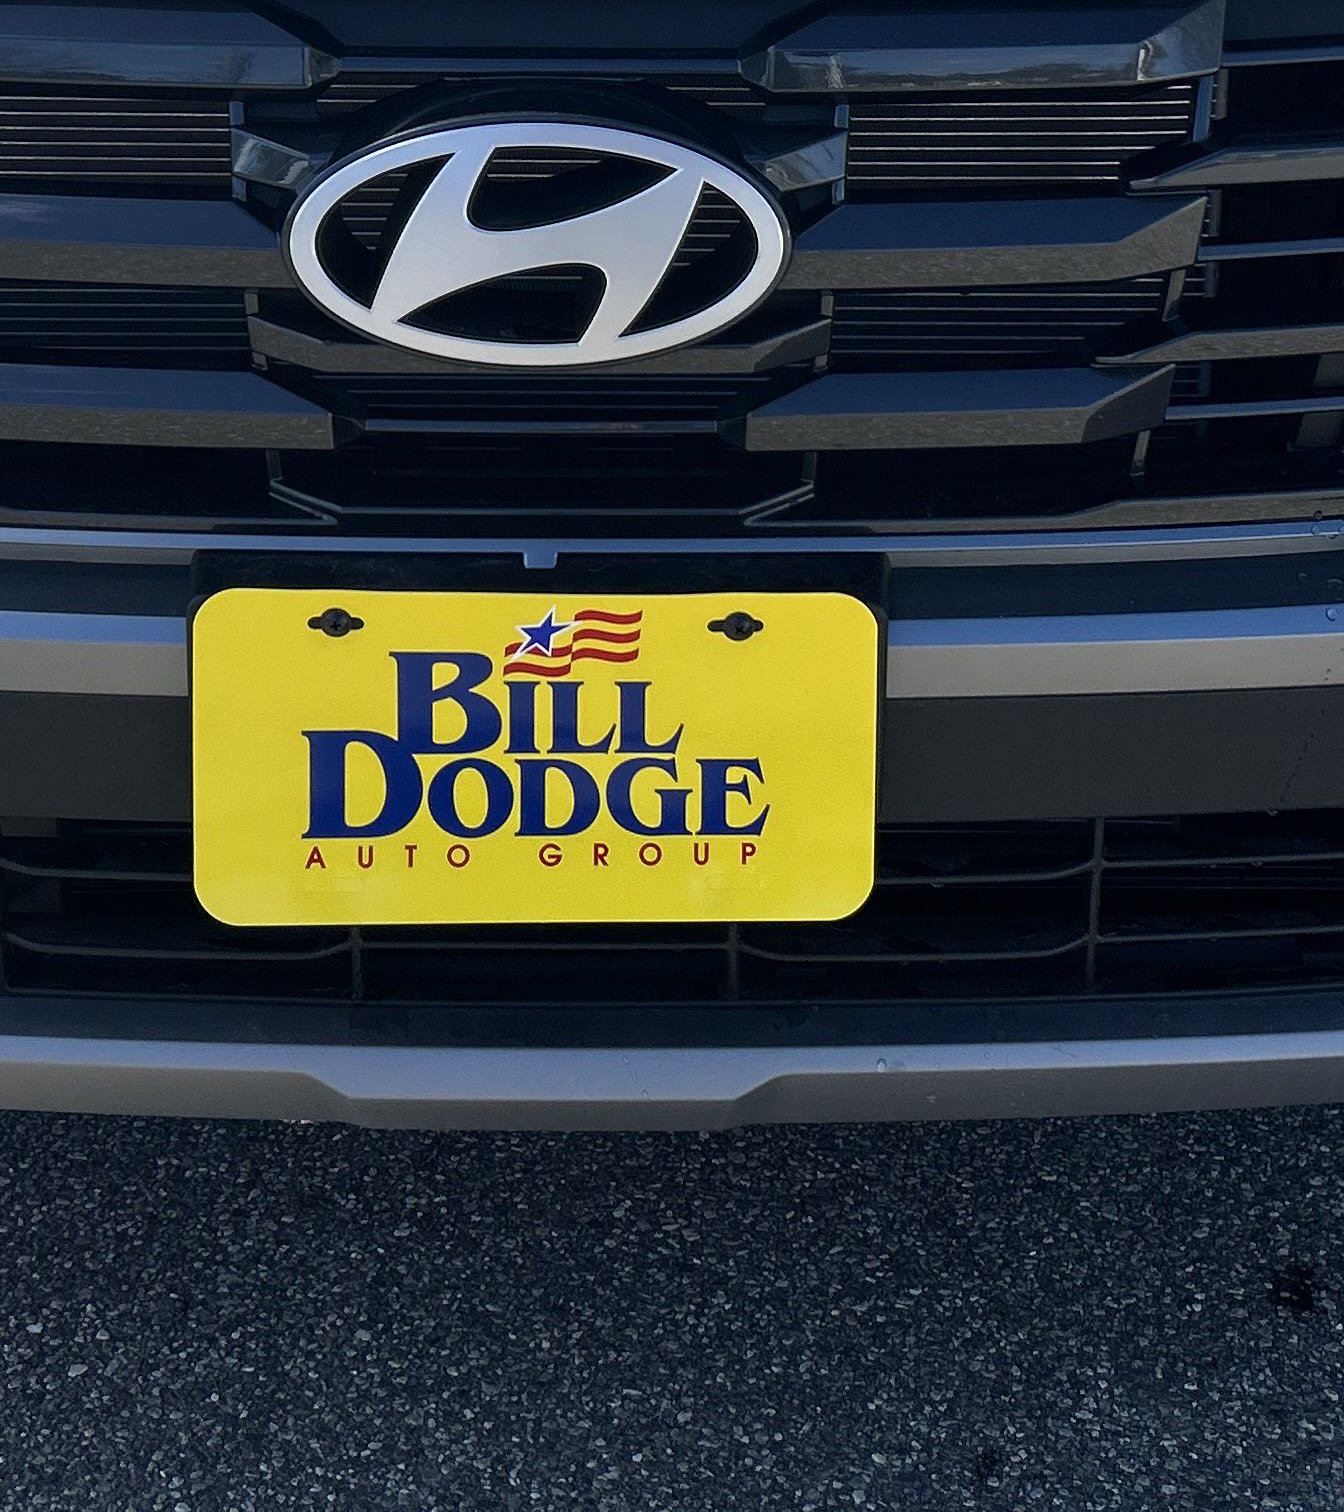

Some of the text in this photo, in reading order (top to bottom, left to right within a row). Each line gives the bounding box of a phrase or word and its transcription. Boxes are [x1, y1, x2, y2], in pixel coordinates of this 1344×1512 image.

[388, 651, 685, 755] BILL
[301, 730, 771, 839] DODGE
[304, 841, 758, 870] AUTO GROUP
